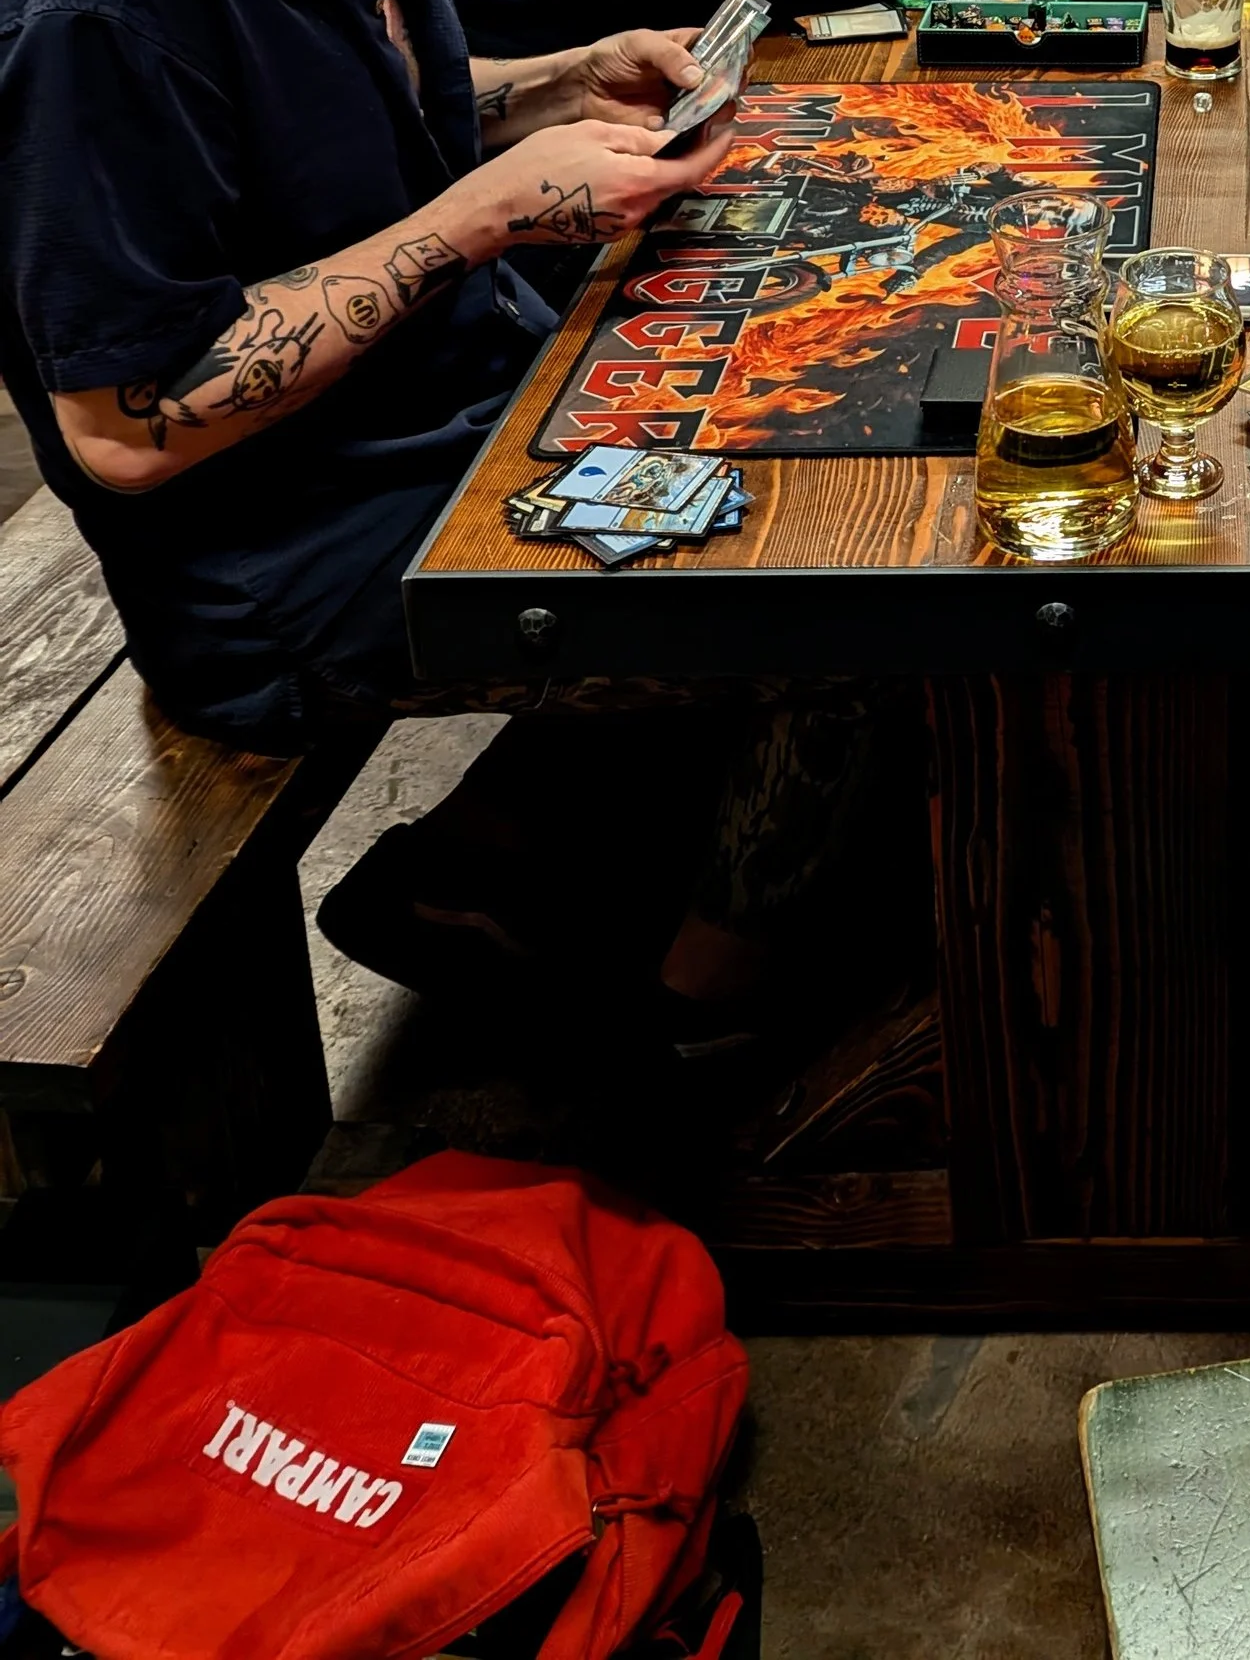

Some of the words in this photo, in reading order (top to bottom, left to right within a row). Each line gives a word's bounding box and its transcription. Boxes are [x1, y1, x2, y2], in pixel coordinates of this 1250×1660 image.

[731, 95, 842, 152] MY
[556, 173, 811, 449] TIGGER
[202, 1406, 403, 1529] CAMPARI
